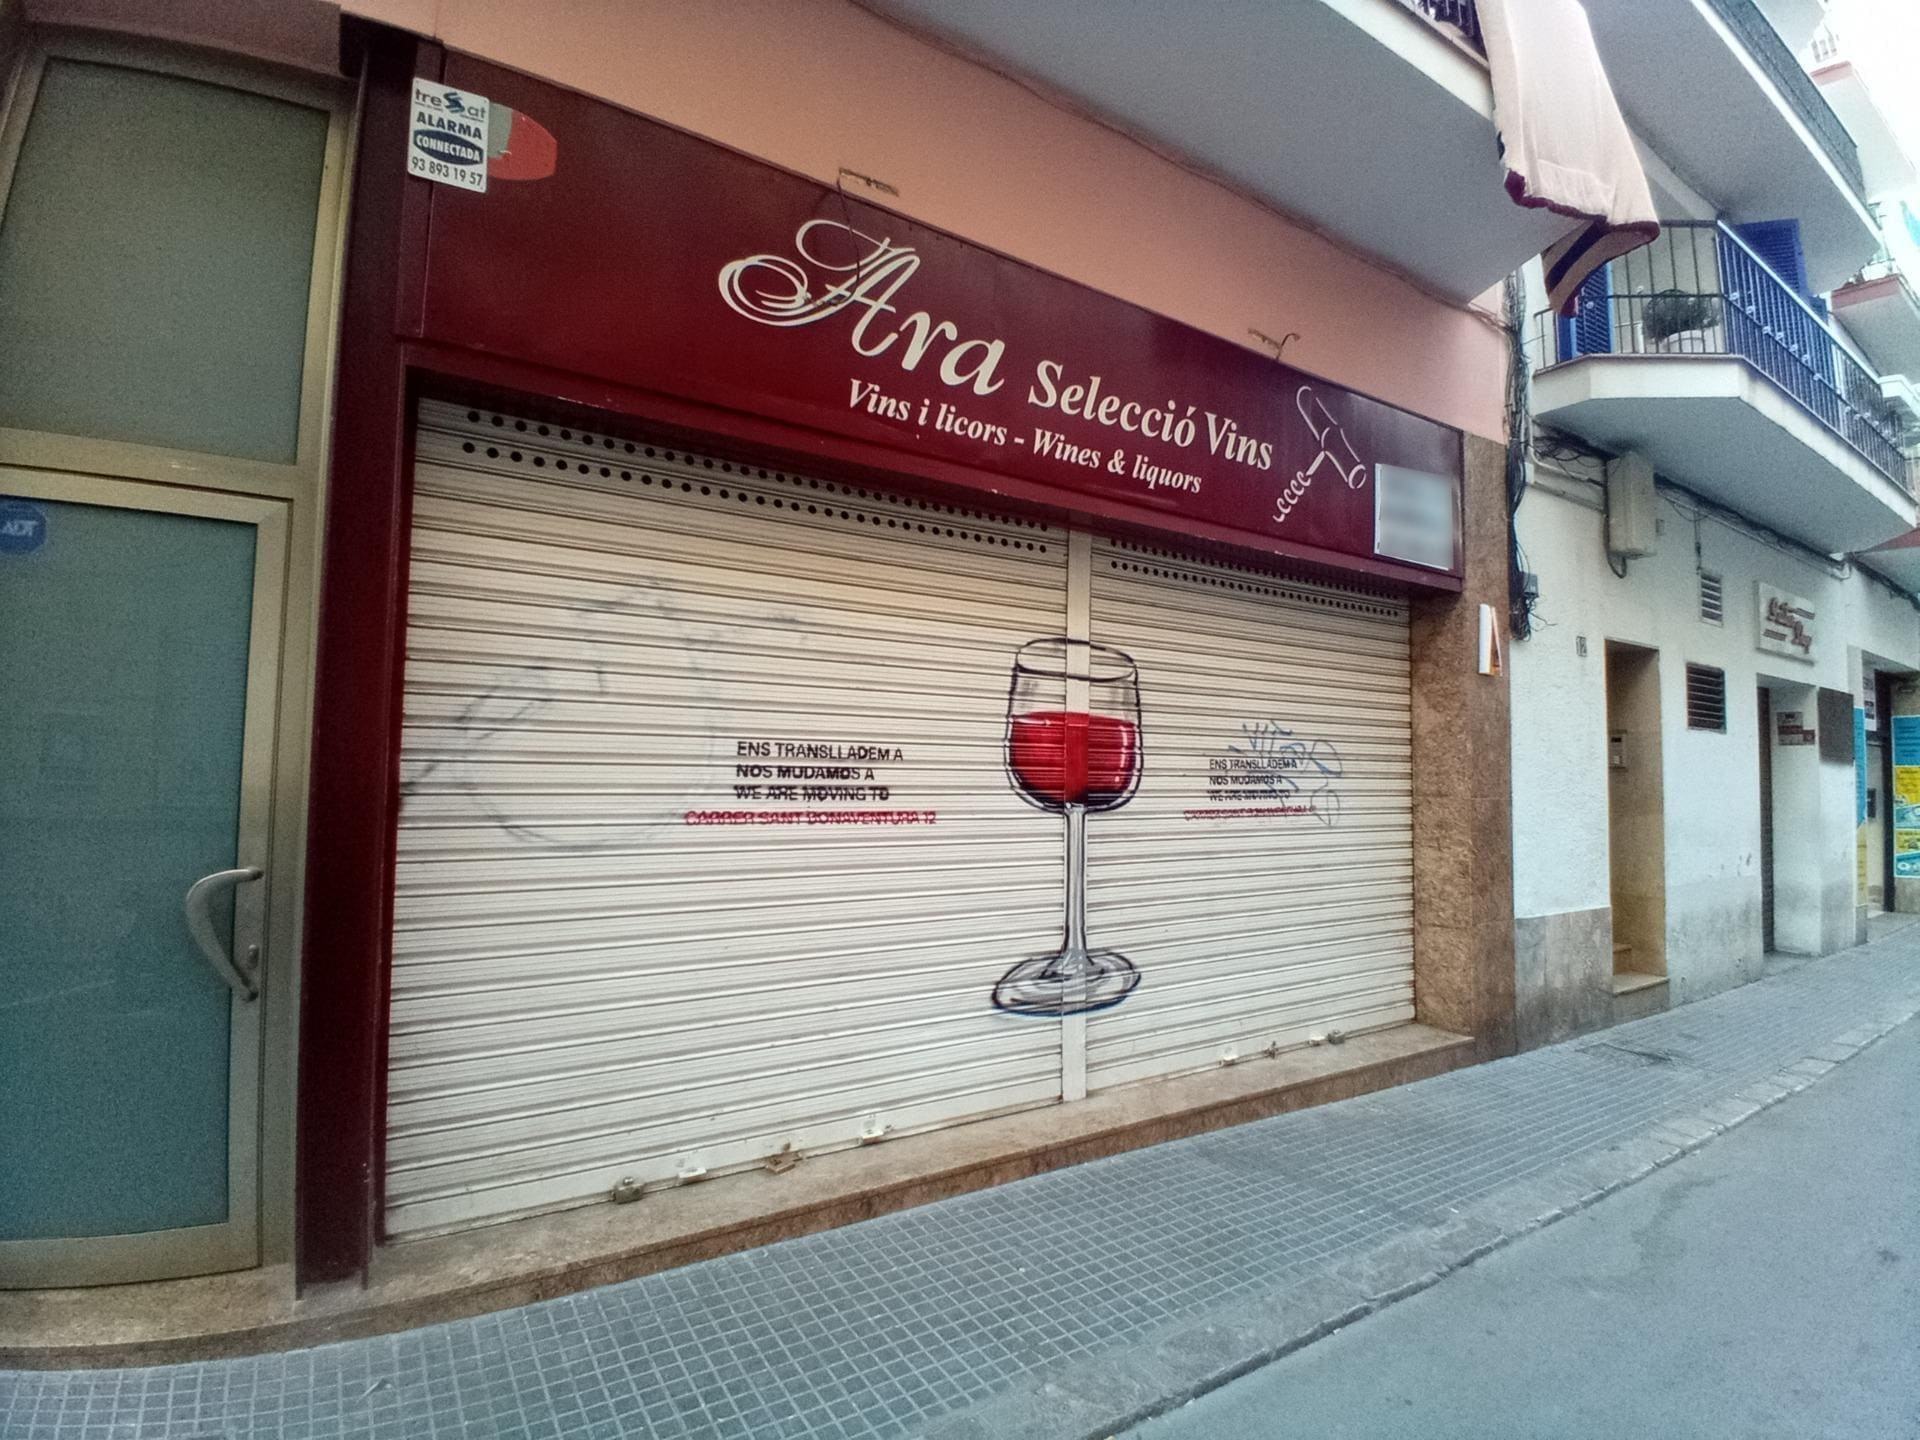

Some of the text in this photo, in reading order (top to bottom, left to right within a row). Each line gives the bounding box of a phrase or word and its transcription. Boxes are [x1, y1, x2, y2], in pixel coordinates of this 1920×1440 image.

[416, 111, 482, 140] ALARMA
[416, 134, 481, 162] CONNECTADA
[411, 156, 483, 186] 93 893 19 57
[718, 219, 1274, 471] Ara Selecció Vins
[848, 377, 910, 422] Vins
[917, 398, 930, 426] i
[935, 402, 1008, 446] licors
[1032, 428, 1102, 469] Wines
[1107, 448, 1126, 475] &
[1132, 454, 1203, 494] liquors
[737, 741, 904, 762] ENS TRANSLLADEM A
[735, 764, 875, 781] NOS MUDAMOS A
[1209, 758, 1228, 770] ENS
[1209, 775, 1229, 786] NOS
[733, 785, 890, 802] WE ARE MOVING TO
